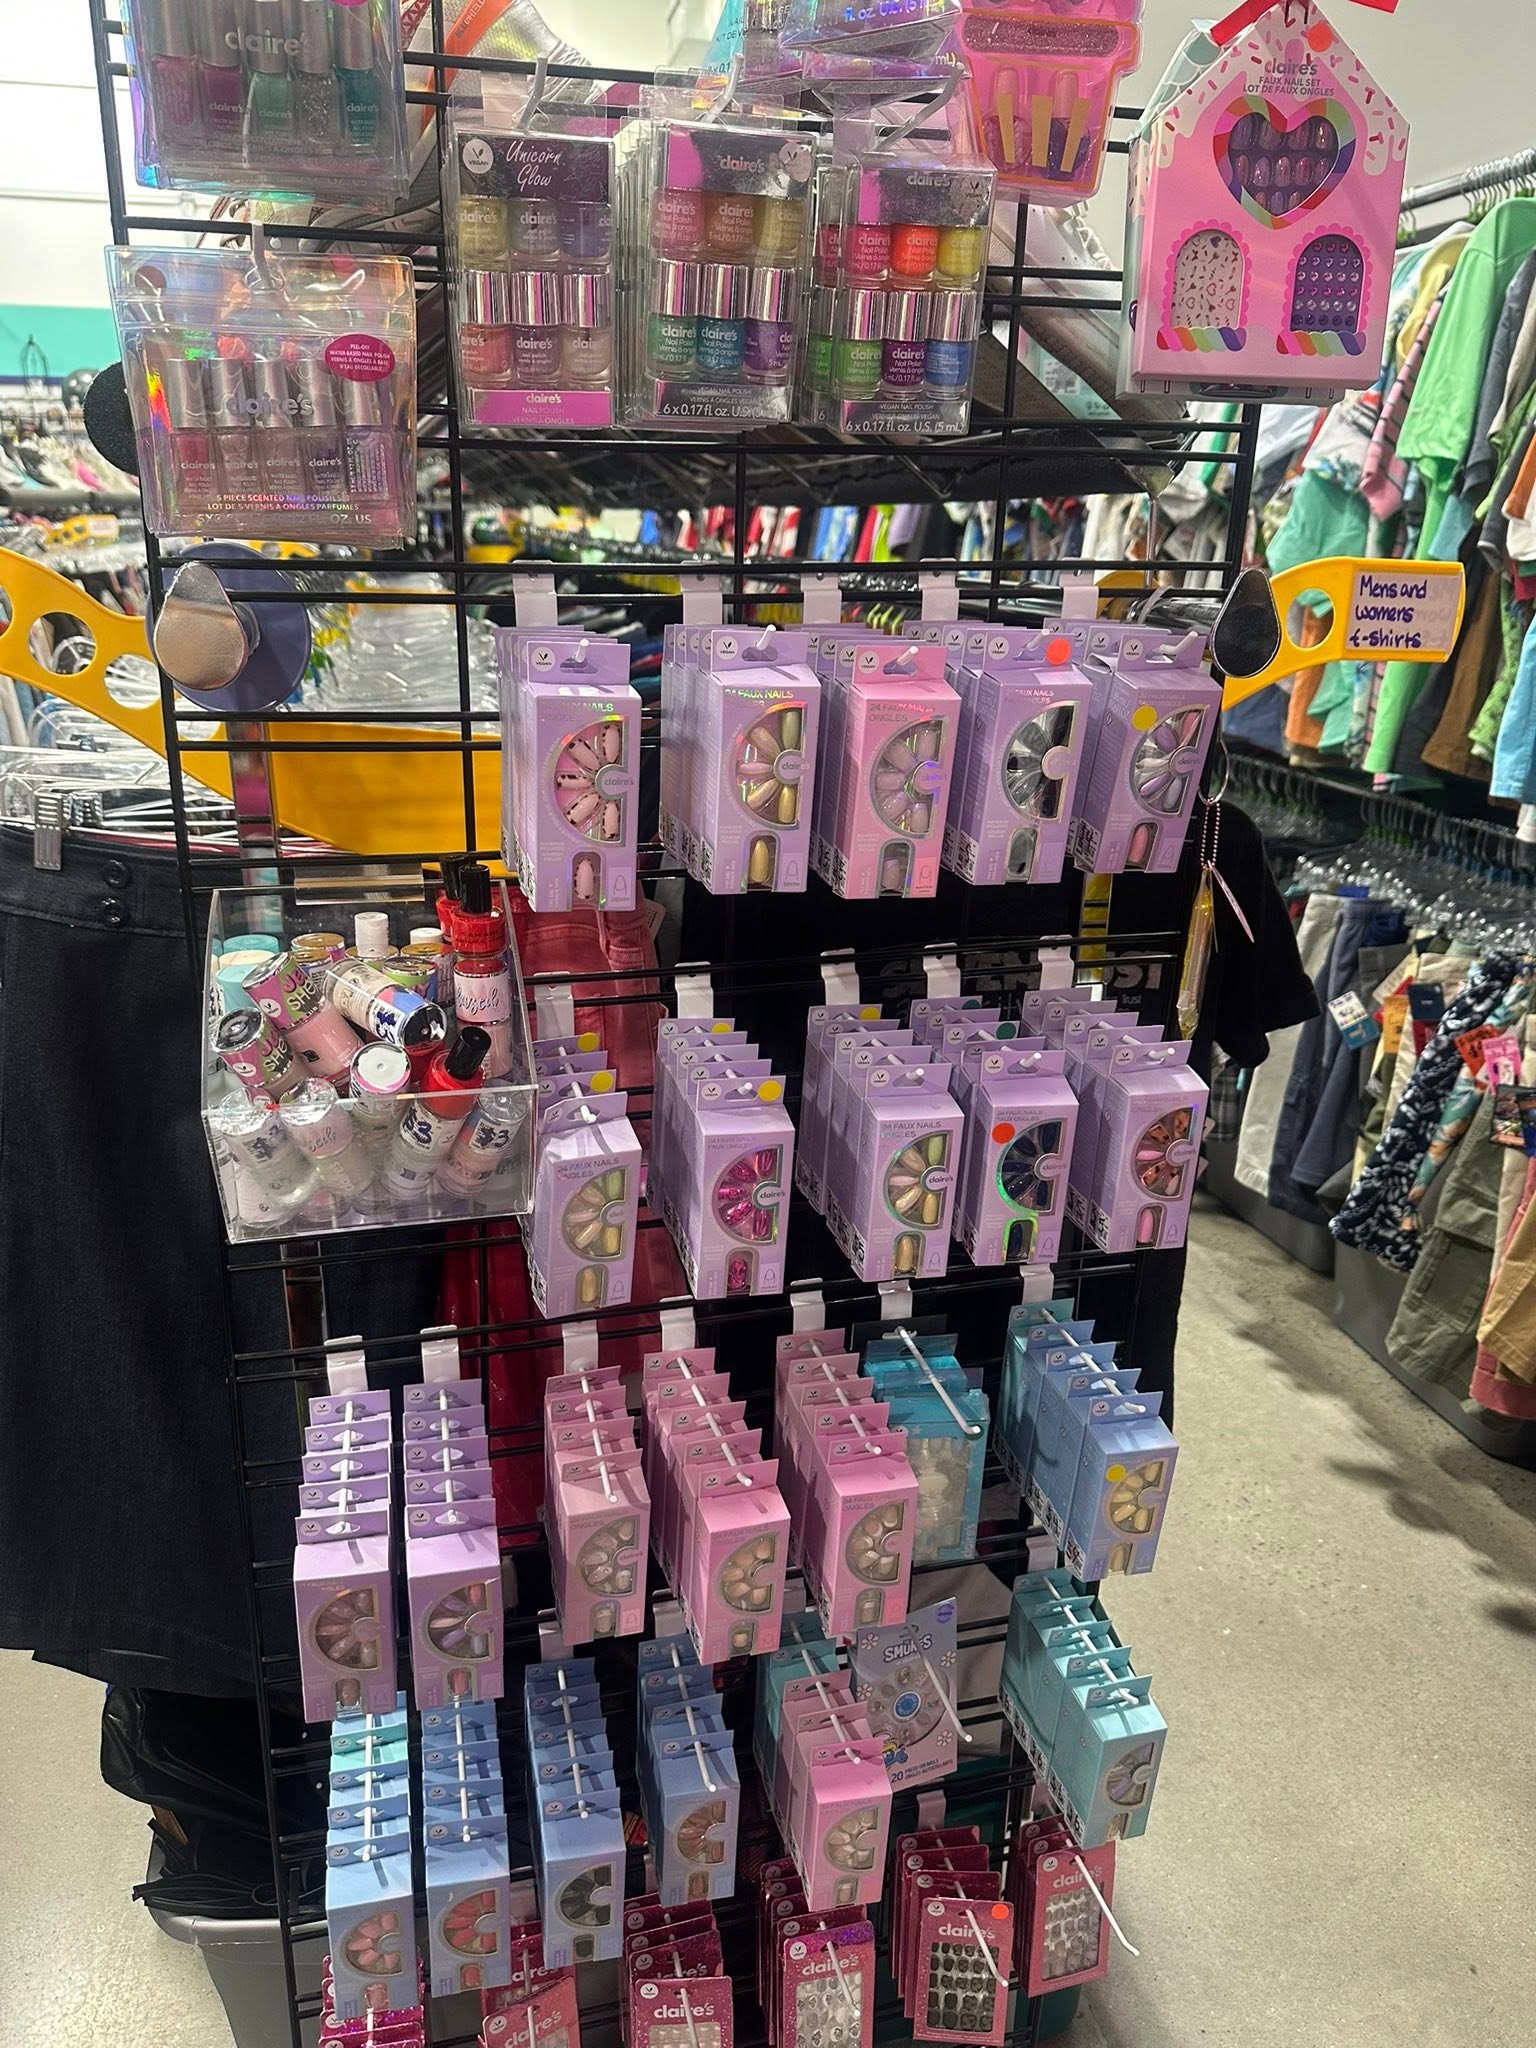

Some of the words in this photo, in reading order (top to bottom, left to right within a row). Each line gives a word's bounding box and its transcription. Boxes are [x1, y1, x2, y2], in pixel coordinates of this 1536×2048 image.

[1259, 77, 1281, 85] FAUX
[1284, 78, 1303, 86] NAIL
[1305, 79, 1321, 87] SET
[1243, 84, 1259, 92] LOT
[1261, 85, 1273, 93] DE
[1275, 86, 1298, 95] FAUX
[1300, 87, 1335, 96] ONGLES
[505, 139, 563, 166] Unicorn
[719, 155, 766, 173] claire's
[517, 163, 552, 192] Glow
[906, 172, 950, 187] claire's
[701, 327, 739, 341] claire's
[516, 336, 553, 349] claire's
[892, 347, 925, 360] claire's
[526, 393, 562, 404] claire's
[663, 403, 671, 415] 6
[672, 407, 680, 415] x
[681, 404, 704, 416] 0.17
[715, 407, 730, 417] oz.
[846, 421, 853, 431] 6
[863, 421, 883, 432] 0.17
[886, 420, 895, 432] fl.
[898, 424, 911, 432] oz.
[914, 421, 933, 432] U.S.
[309, 457, 342, 468] claire's
[248, 494, 285, 502] SCENTED
[1359, 575, 1398, 598] Mens
[1400, 579, 1428, 599] and
[1349, 628, 1422, 649] t-shirts
[764, 689, 794, 699] NAILS
[893, 1122, 915, 1130] FAUX
[916, 1121, 941, 1129] NAILS
[569, 1162, 592, 1171] FAUX
[593, 1157, 619, 1167] NAILS
[760, 1189, 786, 1199] claire's
[891, 1770, 904, 1783] 20
